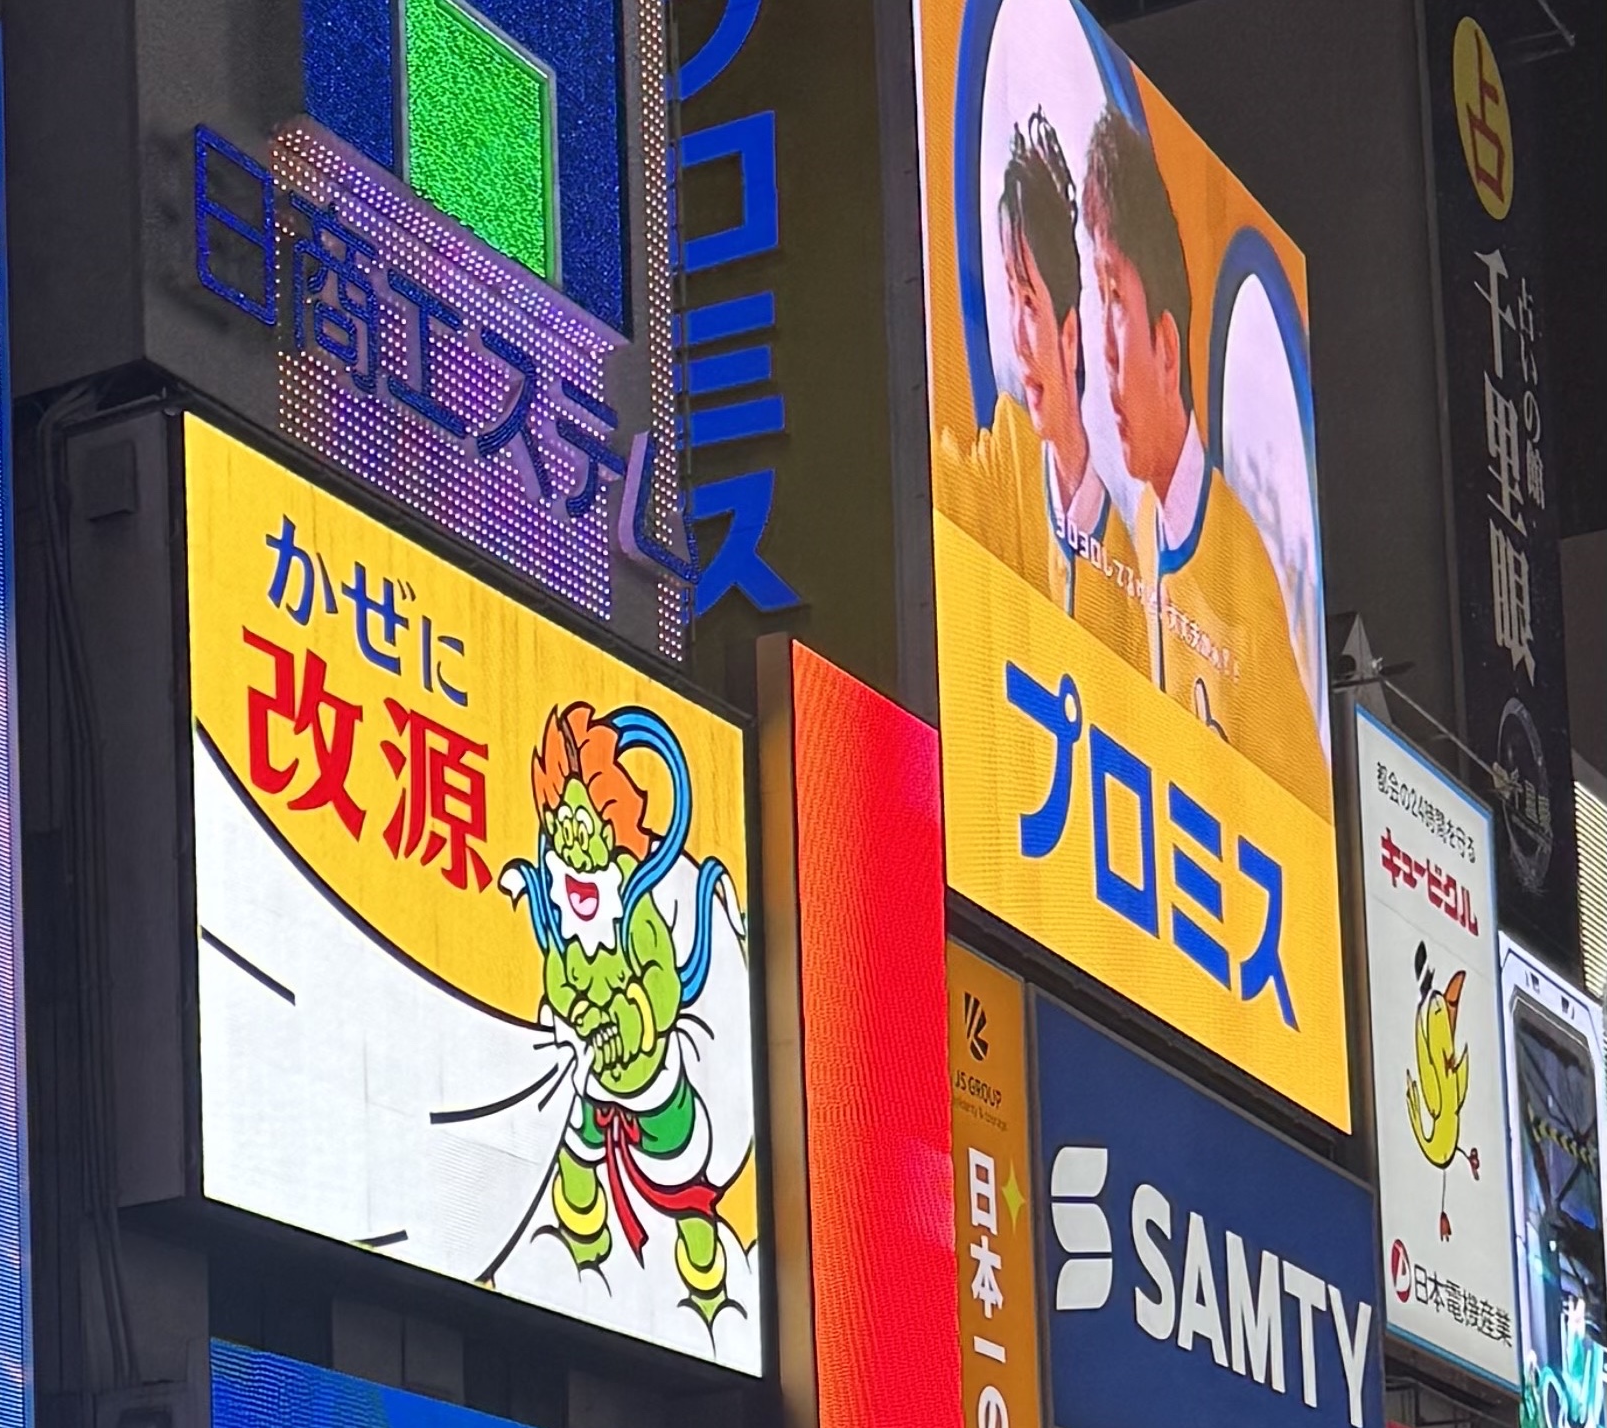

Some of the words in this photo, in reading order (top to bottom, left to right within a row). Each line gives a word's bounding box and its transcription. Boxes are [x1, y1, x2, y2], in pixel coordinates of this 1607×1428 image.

[266, 514, 469, 707] かぜに
[243, 626, 493, 893] 改源
[1006, 660, 1301, 1033] プロミス
[1380, 827, 1480, 937] キュービクル
